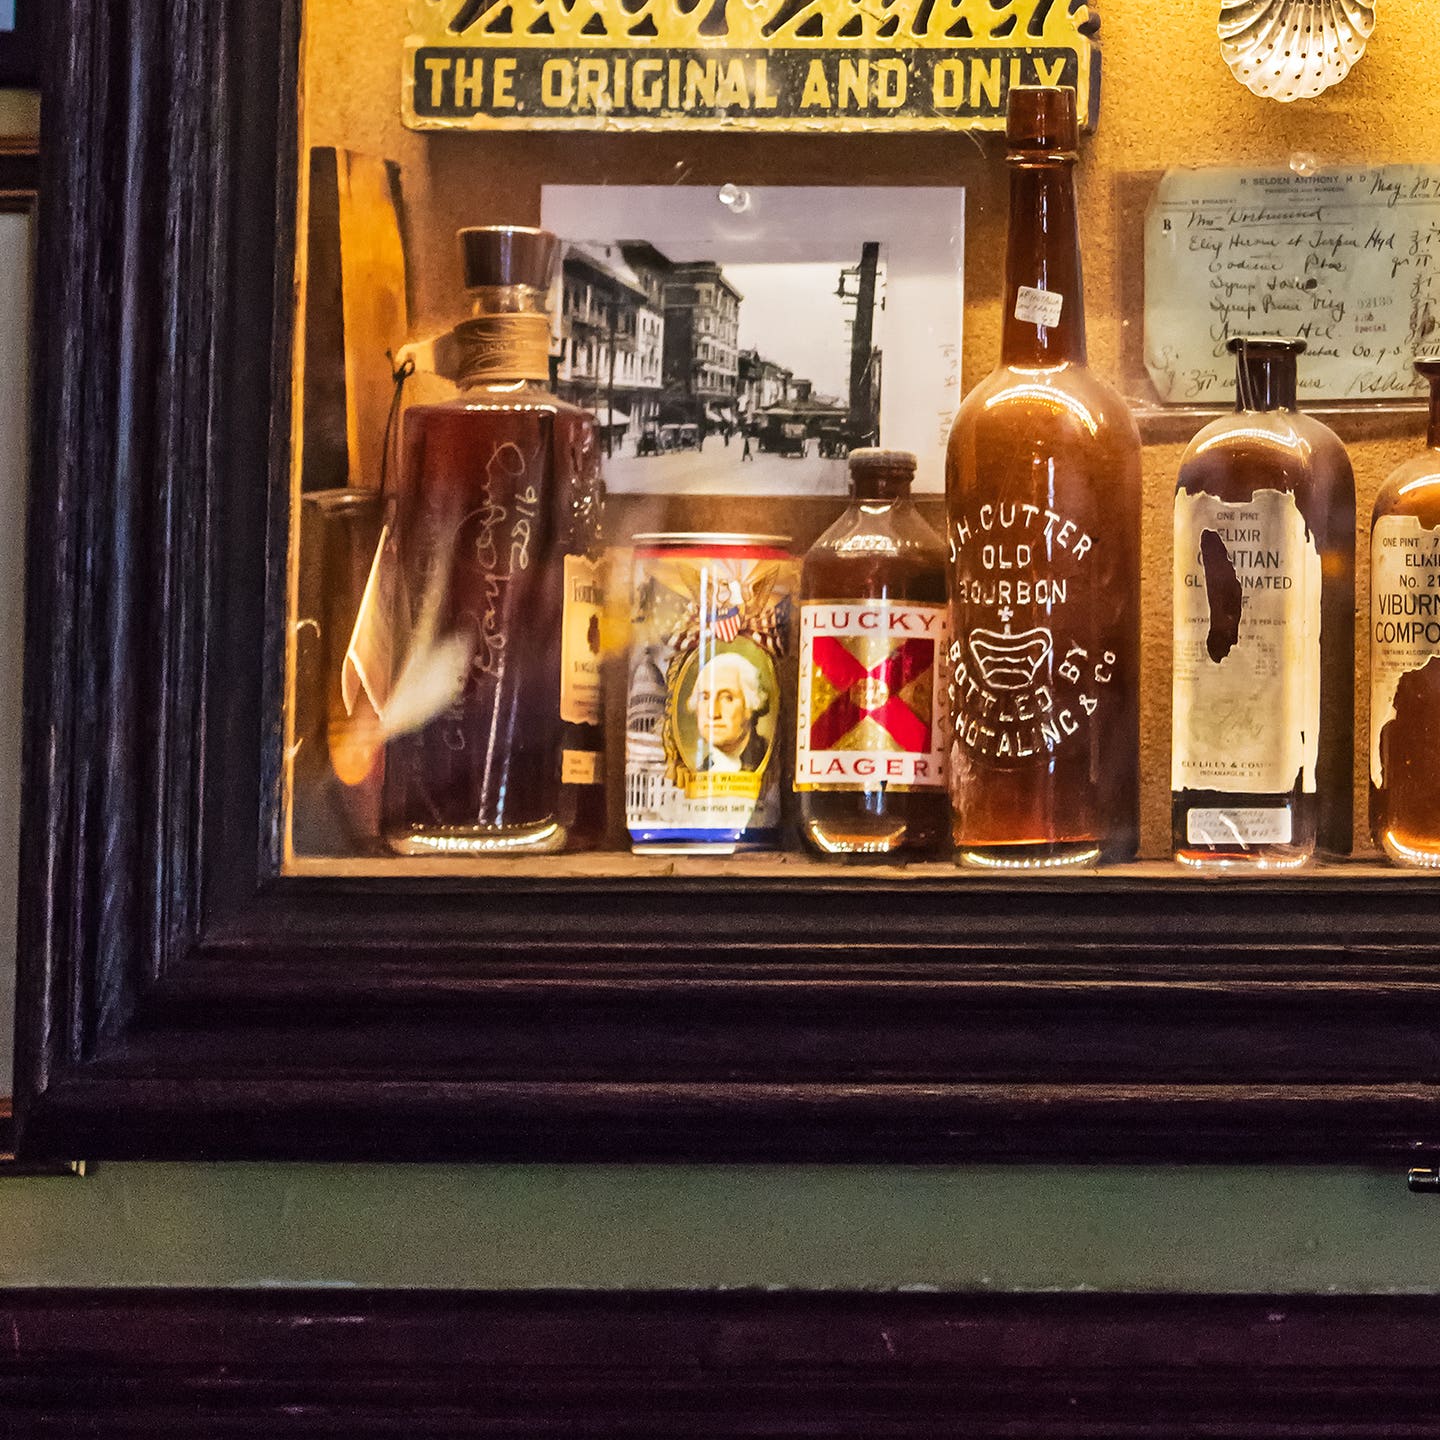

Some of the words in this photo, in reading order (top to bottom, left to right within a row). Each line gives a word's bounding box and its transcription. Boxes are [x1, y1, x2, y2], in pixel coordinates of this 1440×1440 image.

[423, 57, 518, 108] THE
[540, 57, 779, 110] ORIGINAL
[800, 57, 907, 109] AND
[1216, 512, 1235, 521] ONE
[1239, 512, 1260, 521] PINT
[979, 503, 1093, 561] CUTTER
[1217, 528, 1261, 542] ELIXIR
[1382, 537, 1397, 548] ONE
[1400, 537, 1420, 548] PINT
[982, 544, 1031, 570] OLD
[1399, 574, 1420, 589] No.
[812, 611, 937, 632] LUCKY
[809, 757, 929, 777] LAGER
